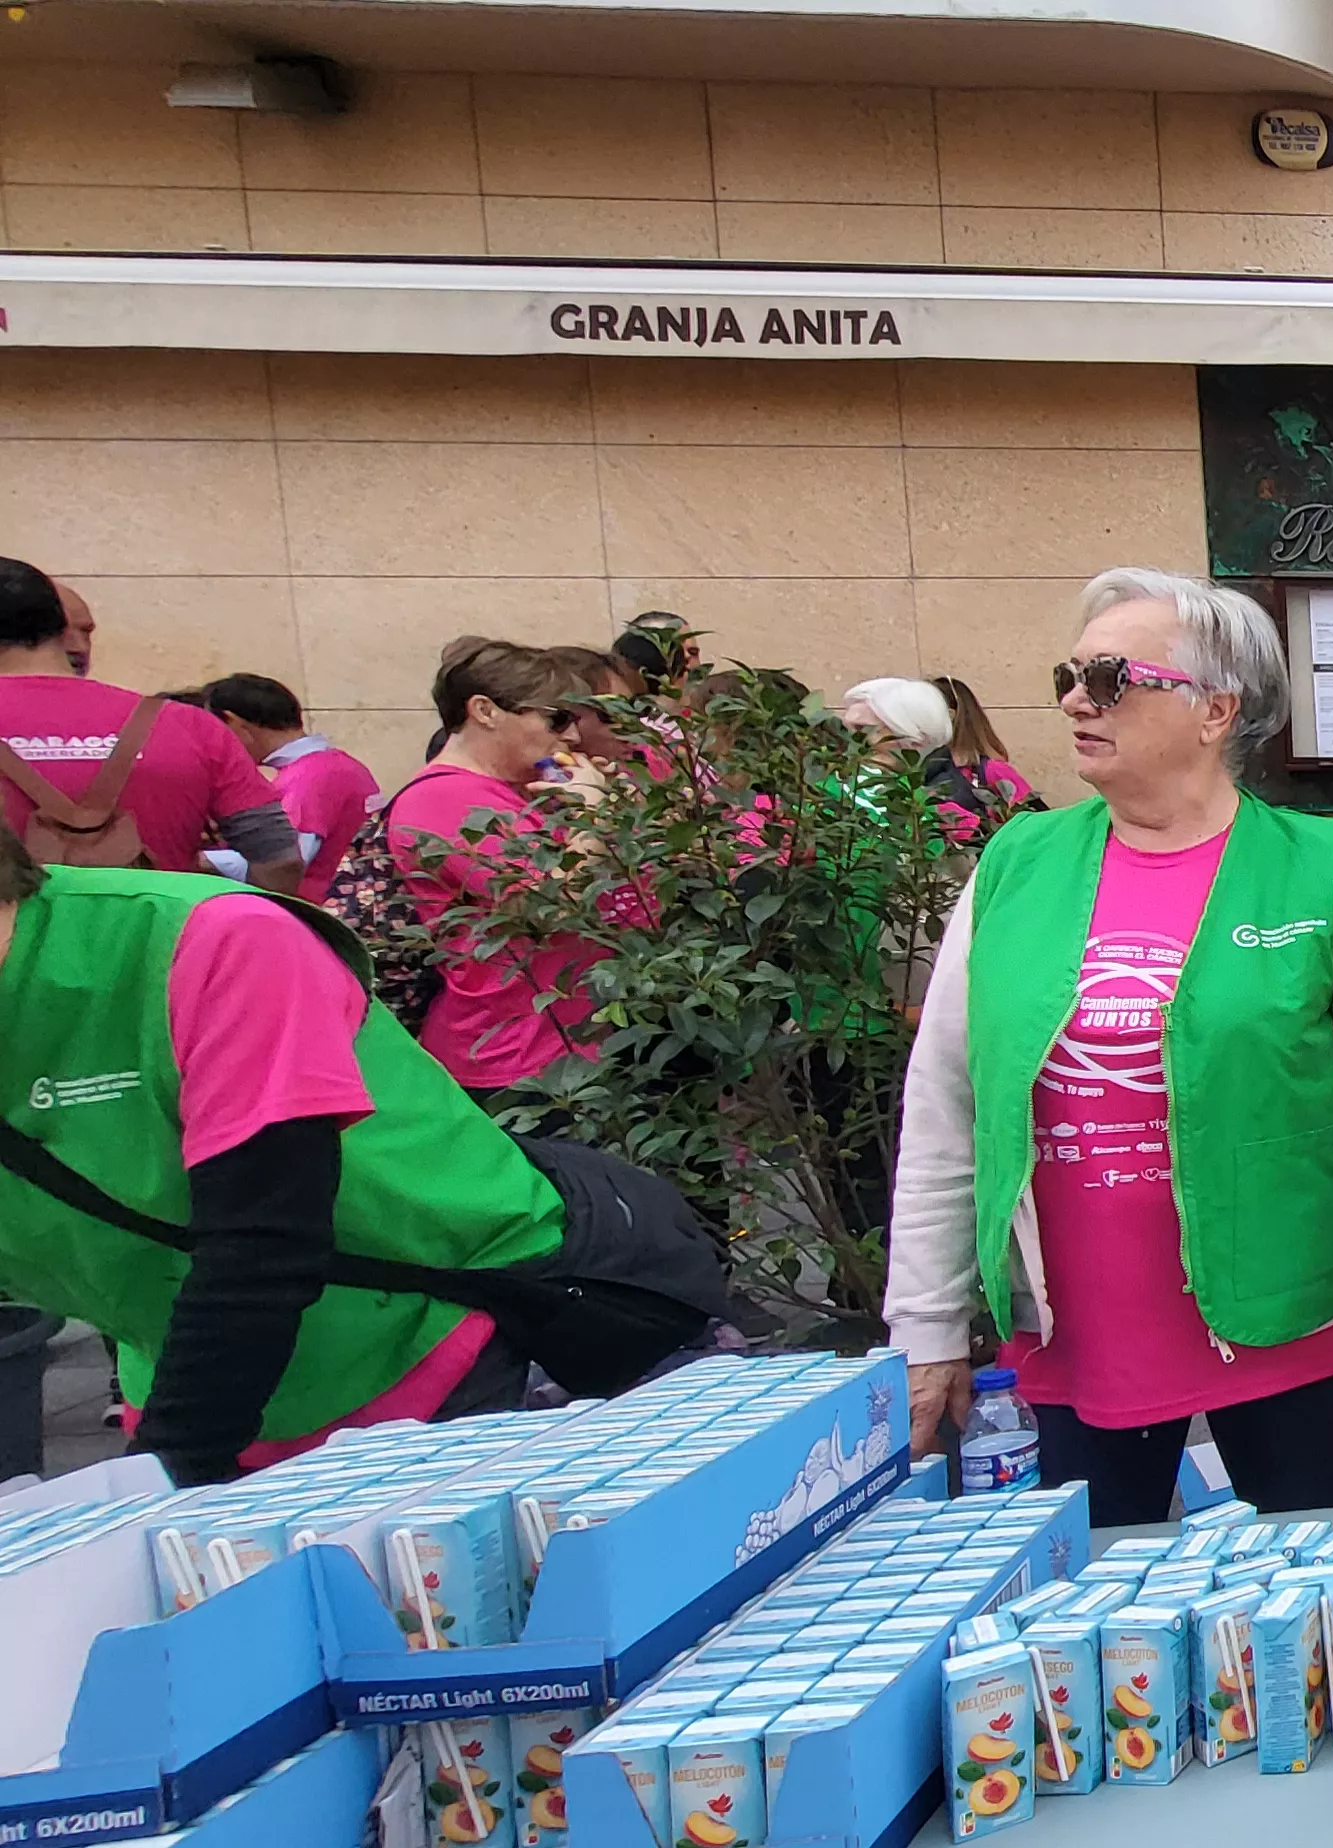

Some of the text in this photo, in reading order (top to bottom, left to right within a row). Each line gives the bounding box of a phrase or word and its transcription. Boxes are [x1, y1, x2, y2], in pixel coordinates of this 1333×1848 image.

[551, 303, 902, 348] GRANJA ANITA
[1080, 996, 1159, 1010] Caminemos
[1080, 1011, 1152, 1027] JUNTOS
[358, 1681, 590, 1713] NÉCTAR Light 6X200ml
[36, 1805, 146, 1838] 6X200ml
